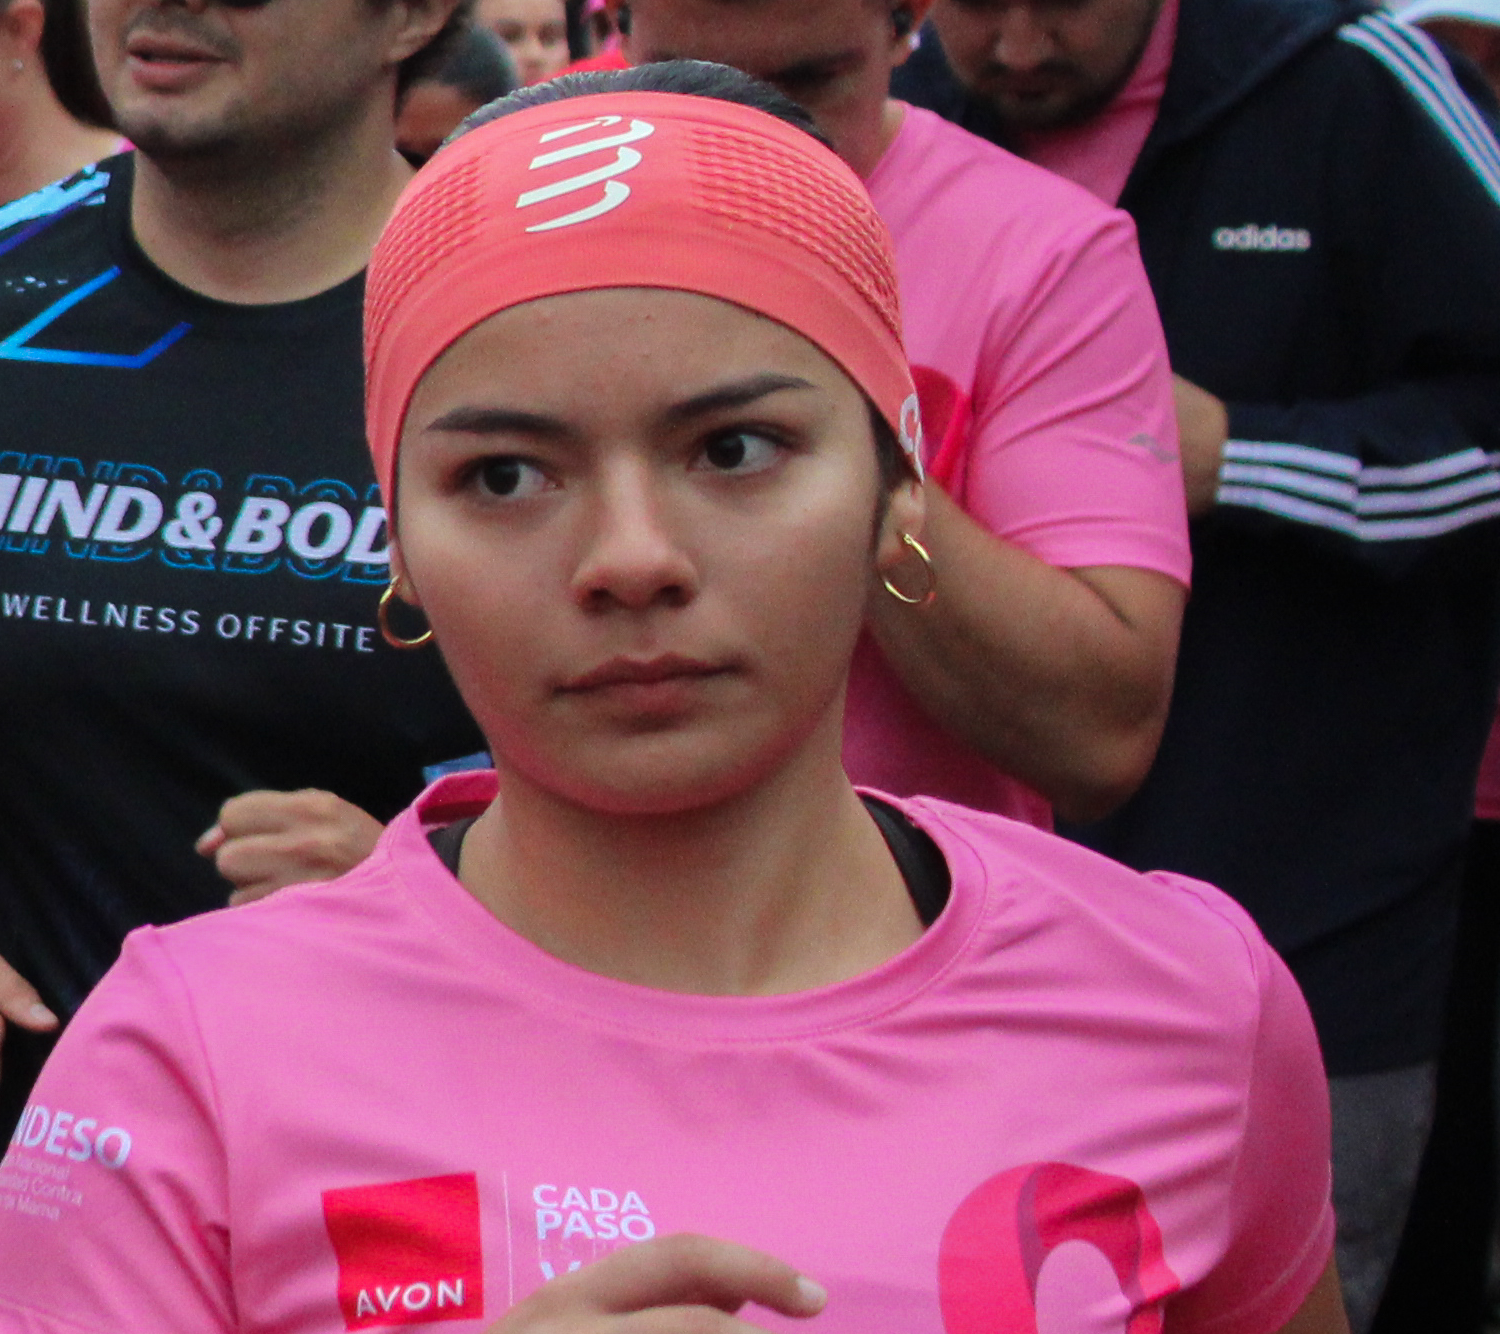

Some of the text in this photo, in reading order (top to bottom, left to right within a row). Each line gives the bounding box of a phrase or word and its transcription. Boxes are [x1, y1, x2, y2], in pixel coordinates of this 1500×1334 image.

[1211, 223, 1311, 251] adidas
[2, 591, 377, 653] WELLNESS OFFSITE
[533, 1184, 650, 1214] CADA
[536, 1208, 656, 1241] PASO
[356, 1278, 465, 1317] AVON
